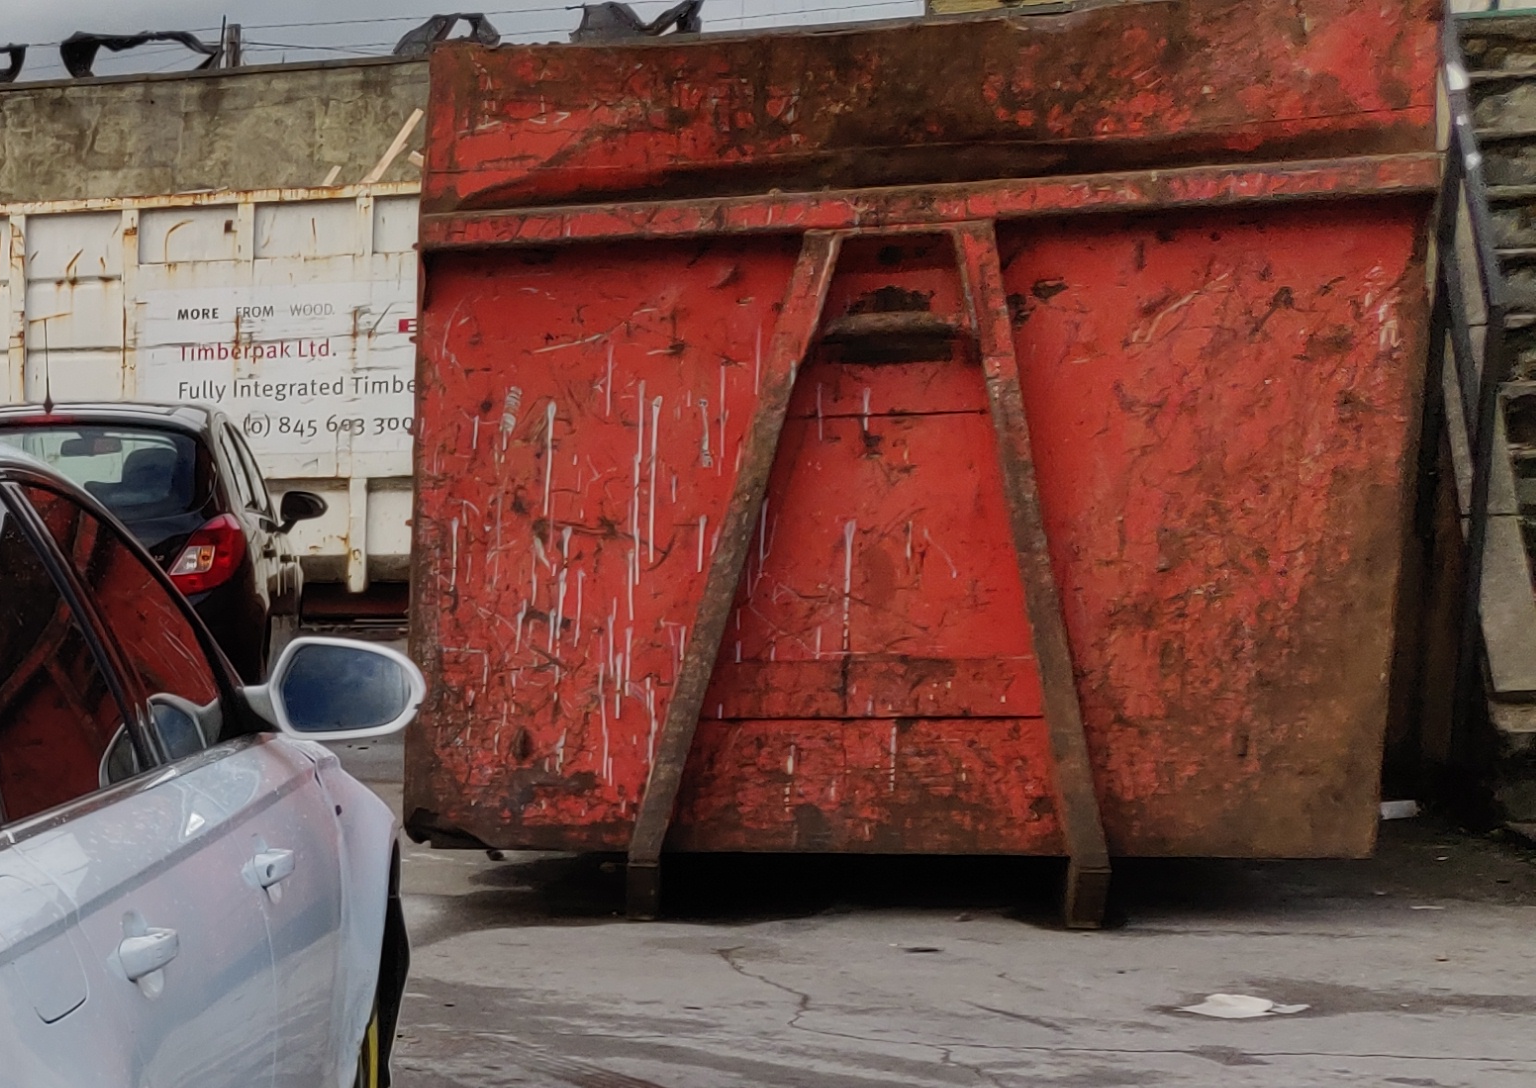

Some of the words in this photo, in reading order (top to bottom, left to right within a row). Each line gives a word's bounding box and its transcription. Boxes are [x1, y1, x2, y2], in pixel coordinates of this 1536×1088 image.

[177, 308, 220, 320] MORE
[235, 305, 275, 318] FROM
[289, 303, 336, 316] WOOD.
[179, 340, 292, 364] Timberpak
[298, 338, 337, 358] Ltd.
[178, 380, 226, 403] Fully
[233, 376, 344, 401] Integrated
[278, 416, 318, 438] 845
